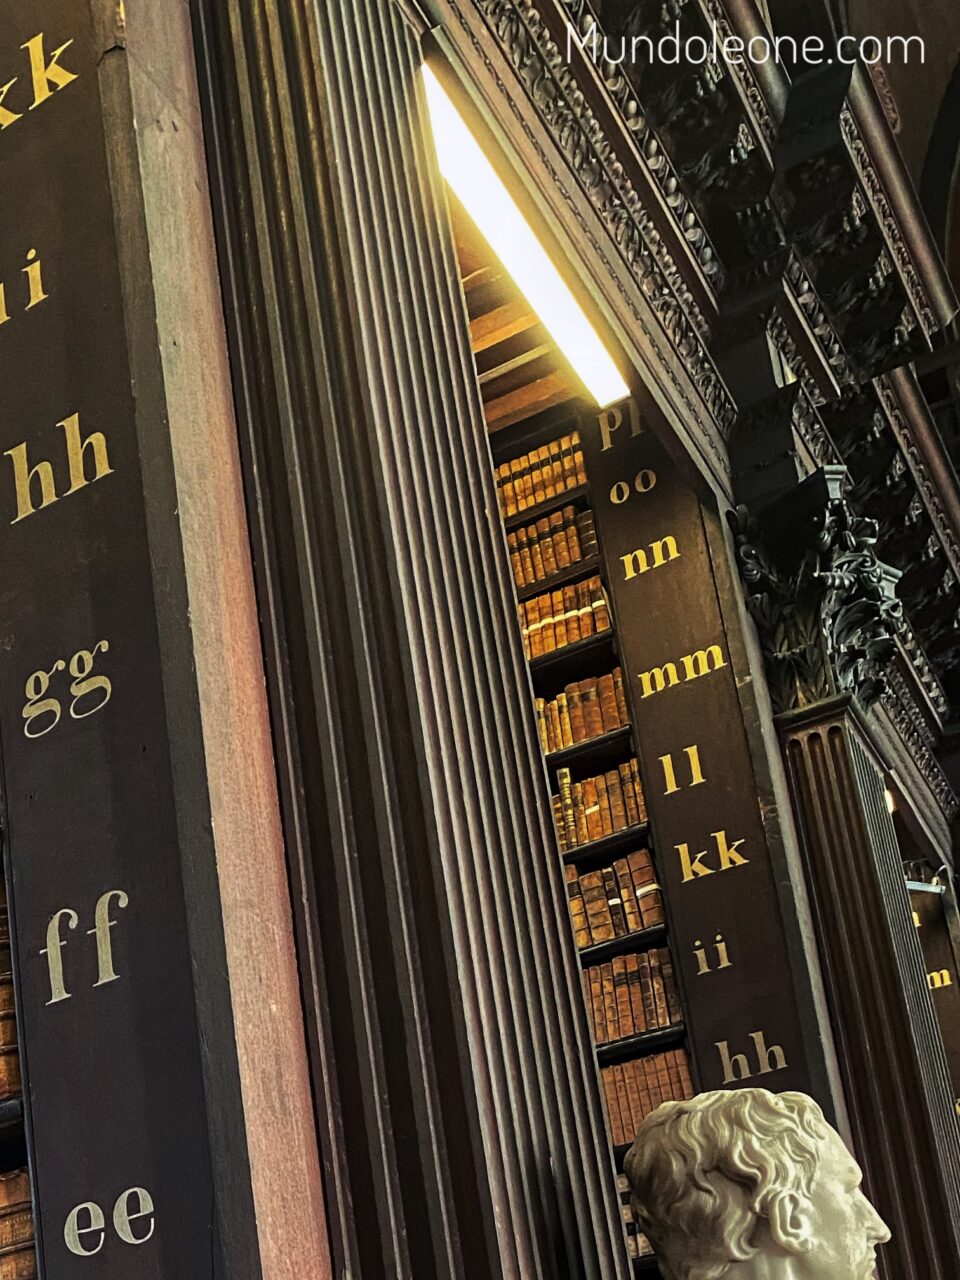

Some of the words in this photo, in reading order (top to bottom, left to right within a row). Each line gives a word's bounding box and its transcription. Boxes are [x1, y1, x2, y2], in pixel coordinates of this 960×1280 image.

[3, 411, 115, 525] hh
[610, 469, 657, 504] oo
[620, 534, 681, 581] nn
[22, 640, 112, 738] gg
[637, 644, 728, 698] mm
[674, 830, 750, 883] kk
[39, 889, 129, 1007] ff
[693, 934, 733, 976] ii
[714, 1031, 789, 1085] hh
[64, 1187, 155, 1257] ee
